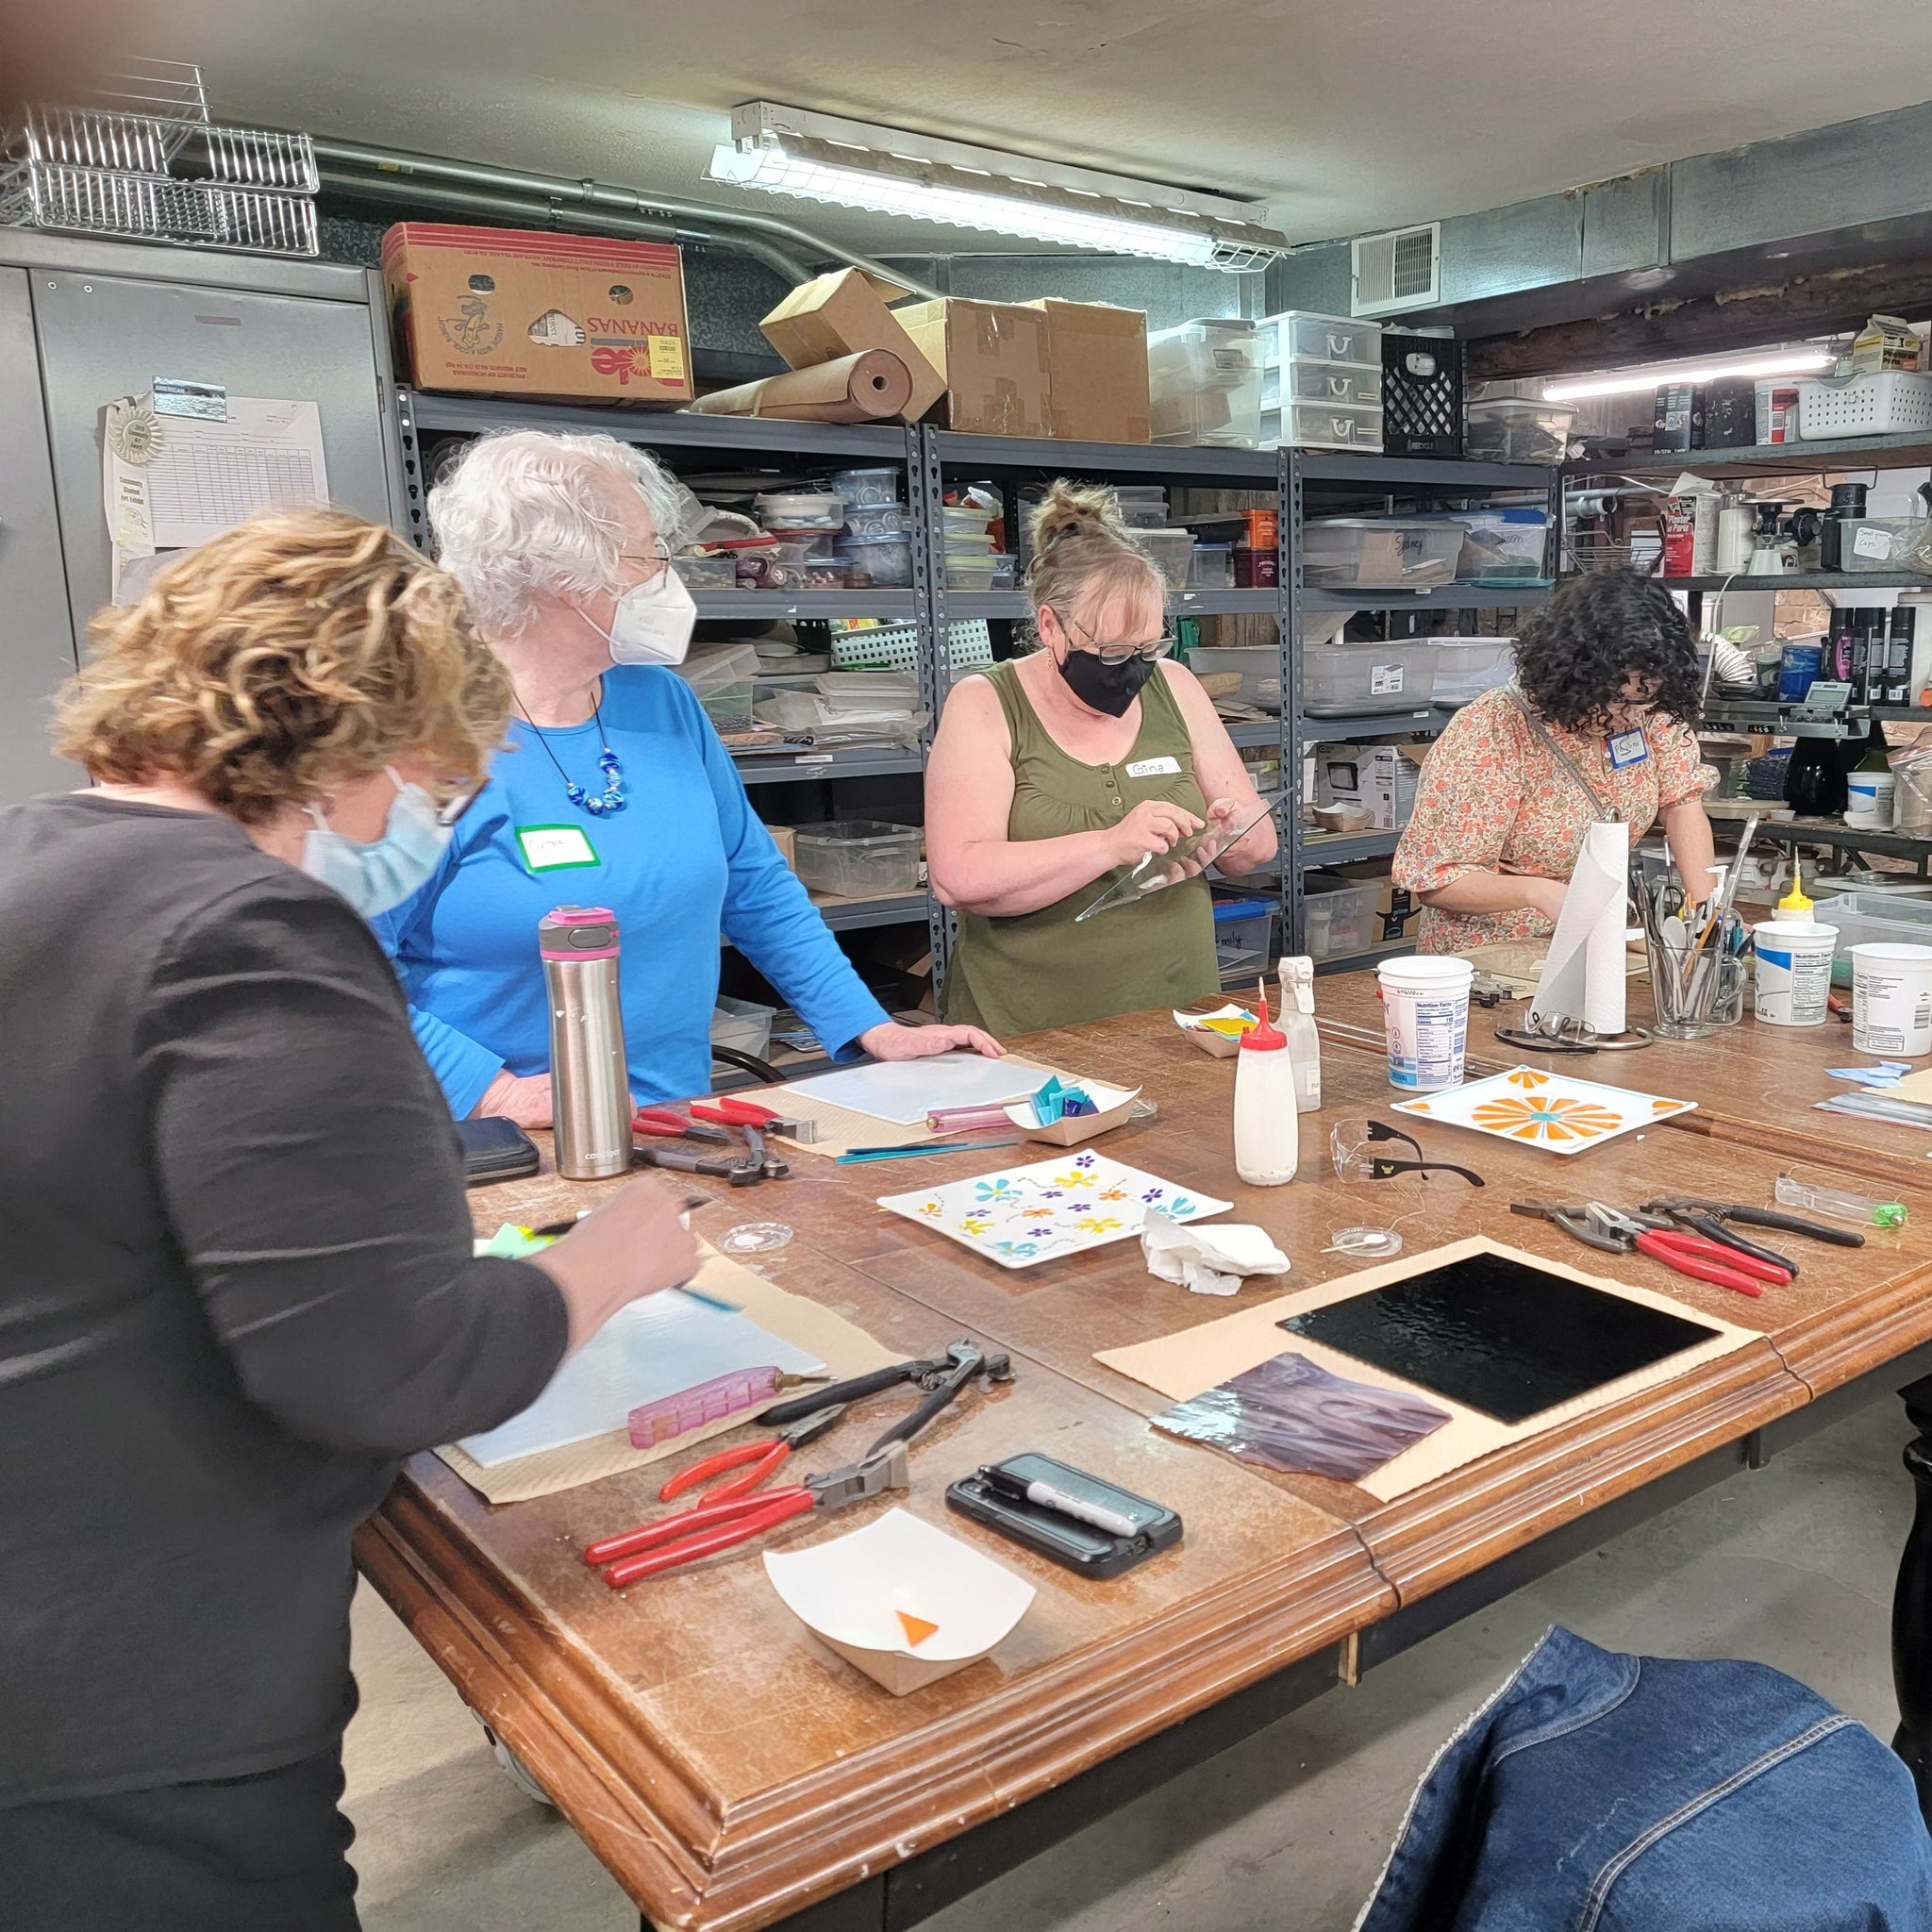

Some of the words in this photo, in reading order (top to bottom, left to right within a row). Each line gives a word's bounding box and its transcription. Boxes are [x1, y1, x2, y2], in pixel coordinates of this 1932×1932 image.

[587, 317, 678, 336] BANANAS
[1395, 536, 1424, 556] Sydney
[1132, 764, 1164, 774] Gina
